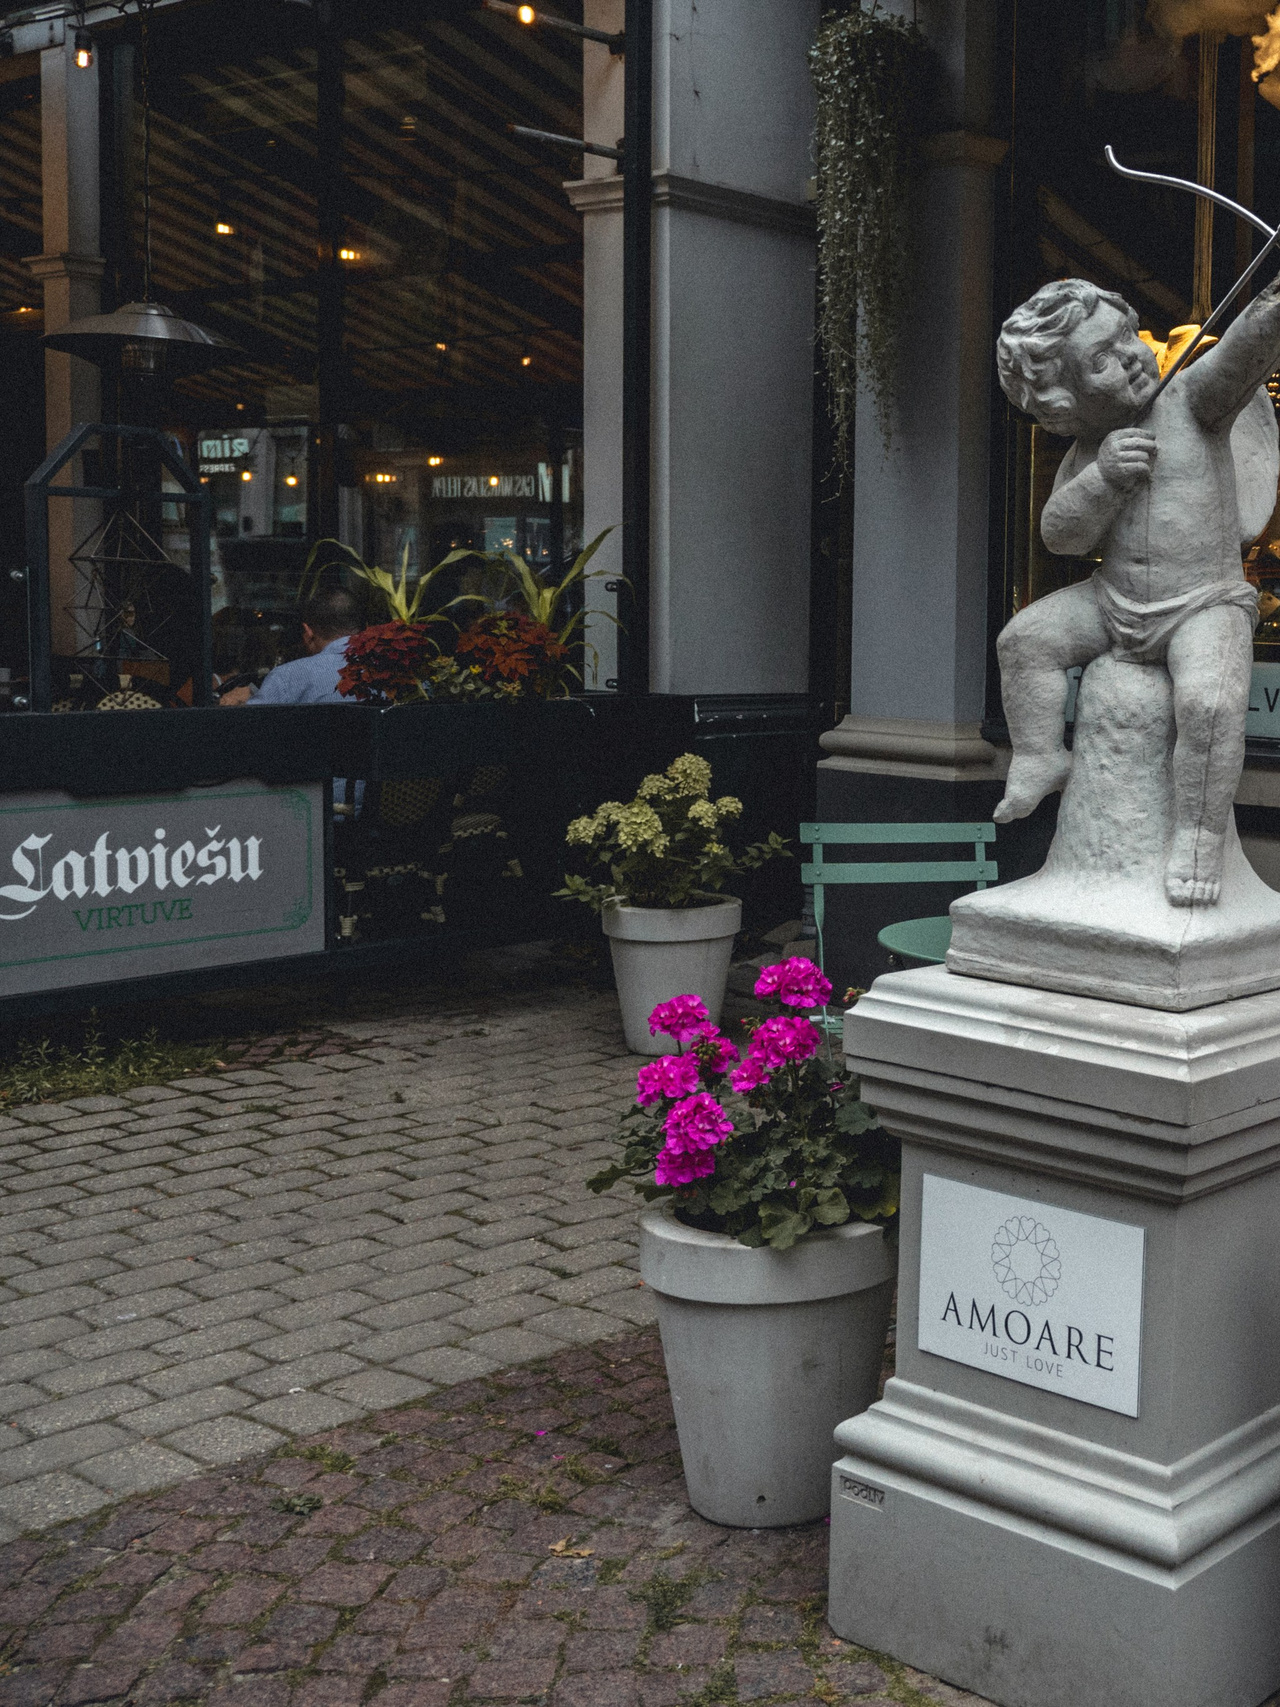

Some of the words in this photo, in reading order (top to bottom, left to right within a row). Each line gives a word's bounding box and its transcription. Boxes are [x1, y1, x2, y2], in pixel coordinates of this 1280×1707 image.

[0, 824, 264, 903] Latviešu
[72, 898, 194, 932] VIRTUVE
[941, 1291, 1114, 1372] AMOARE
[983, 1342, 1018, 1364] JUST
[1026, 1354, 1063, 1378] LOVE
